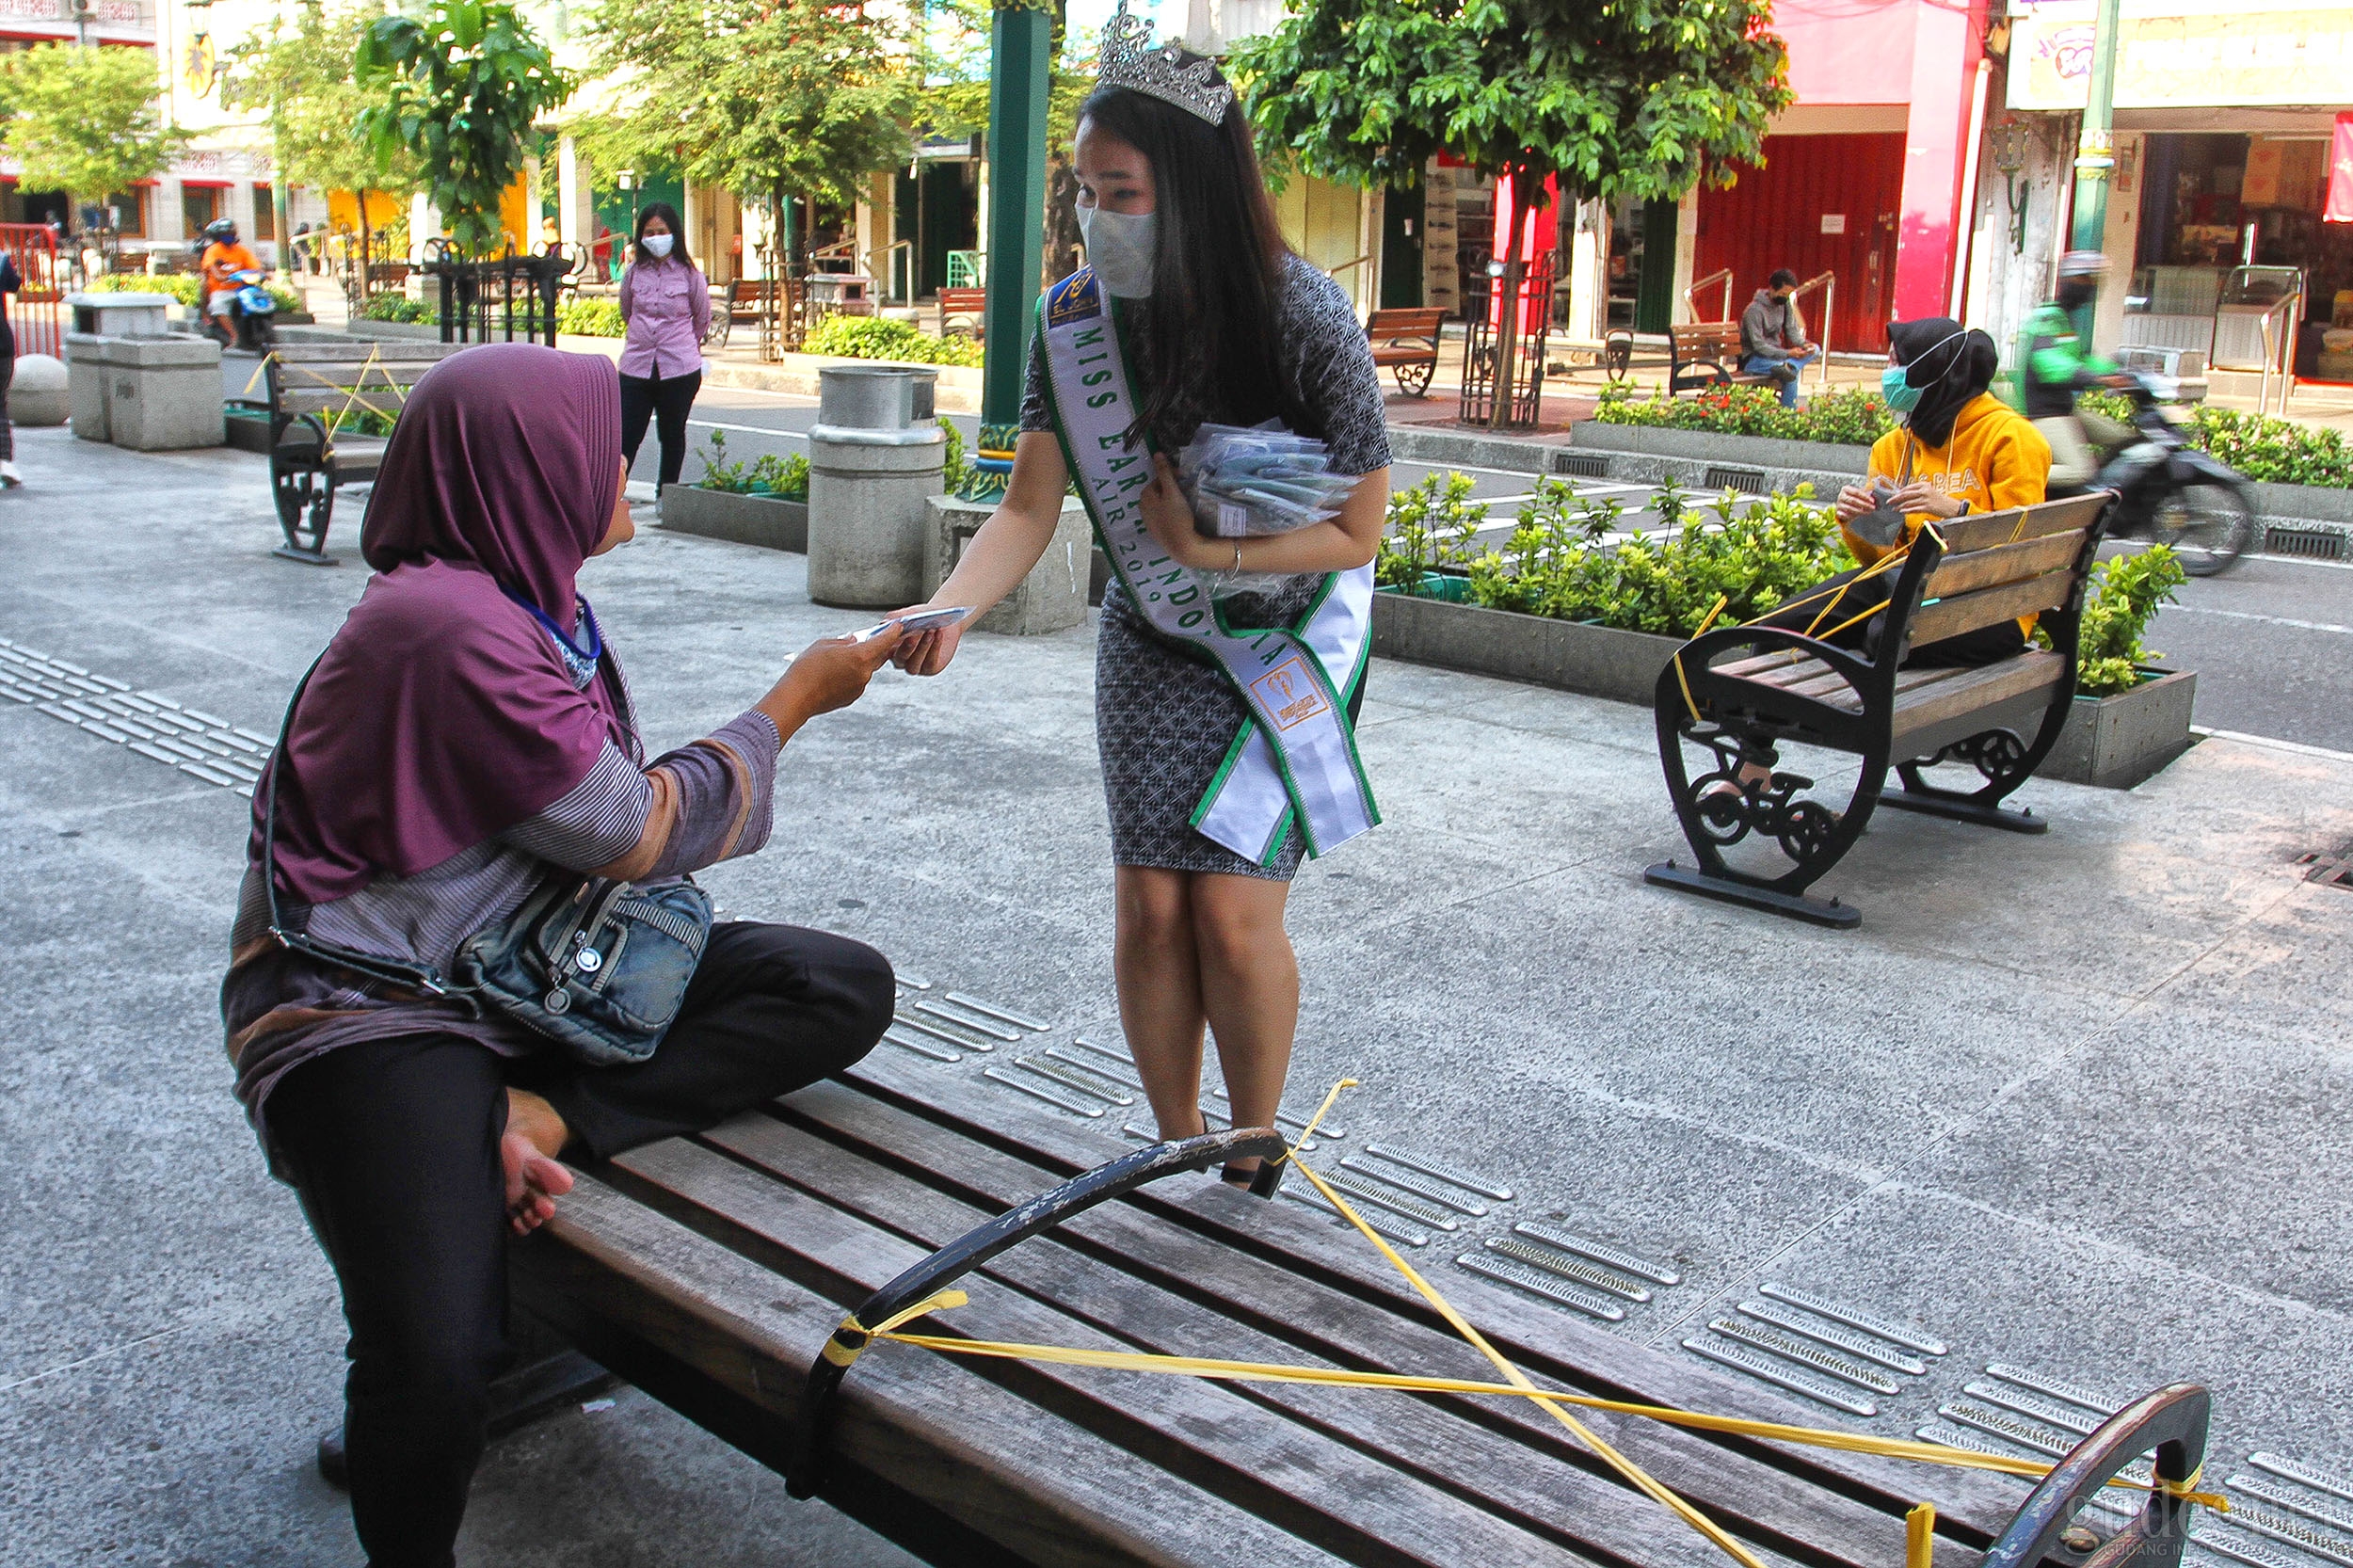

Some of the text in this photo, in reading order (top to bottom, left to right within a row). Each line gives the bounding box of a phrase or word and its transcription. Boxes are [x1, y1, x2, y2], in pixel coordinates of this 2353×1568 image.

[1073, 326, 1117, 408] MISS
[1148, 555, 1288, 667] INDOIA
[1091, 476, 1161, 602] AIR 2019
